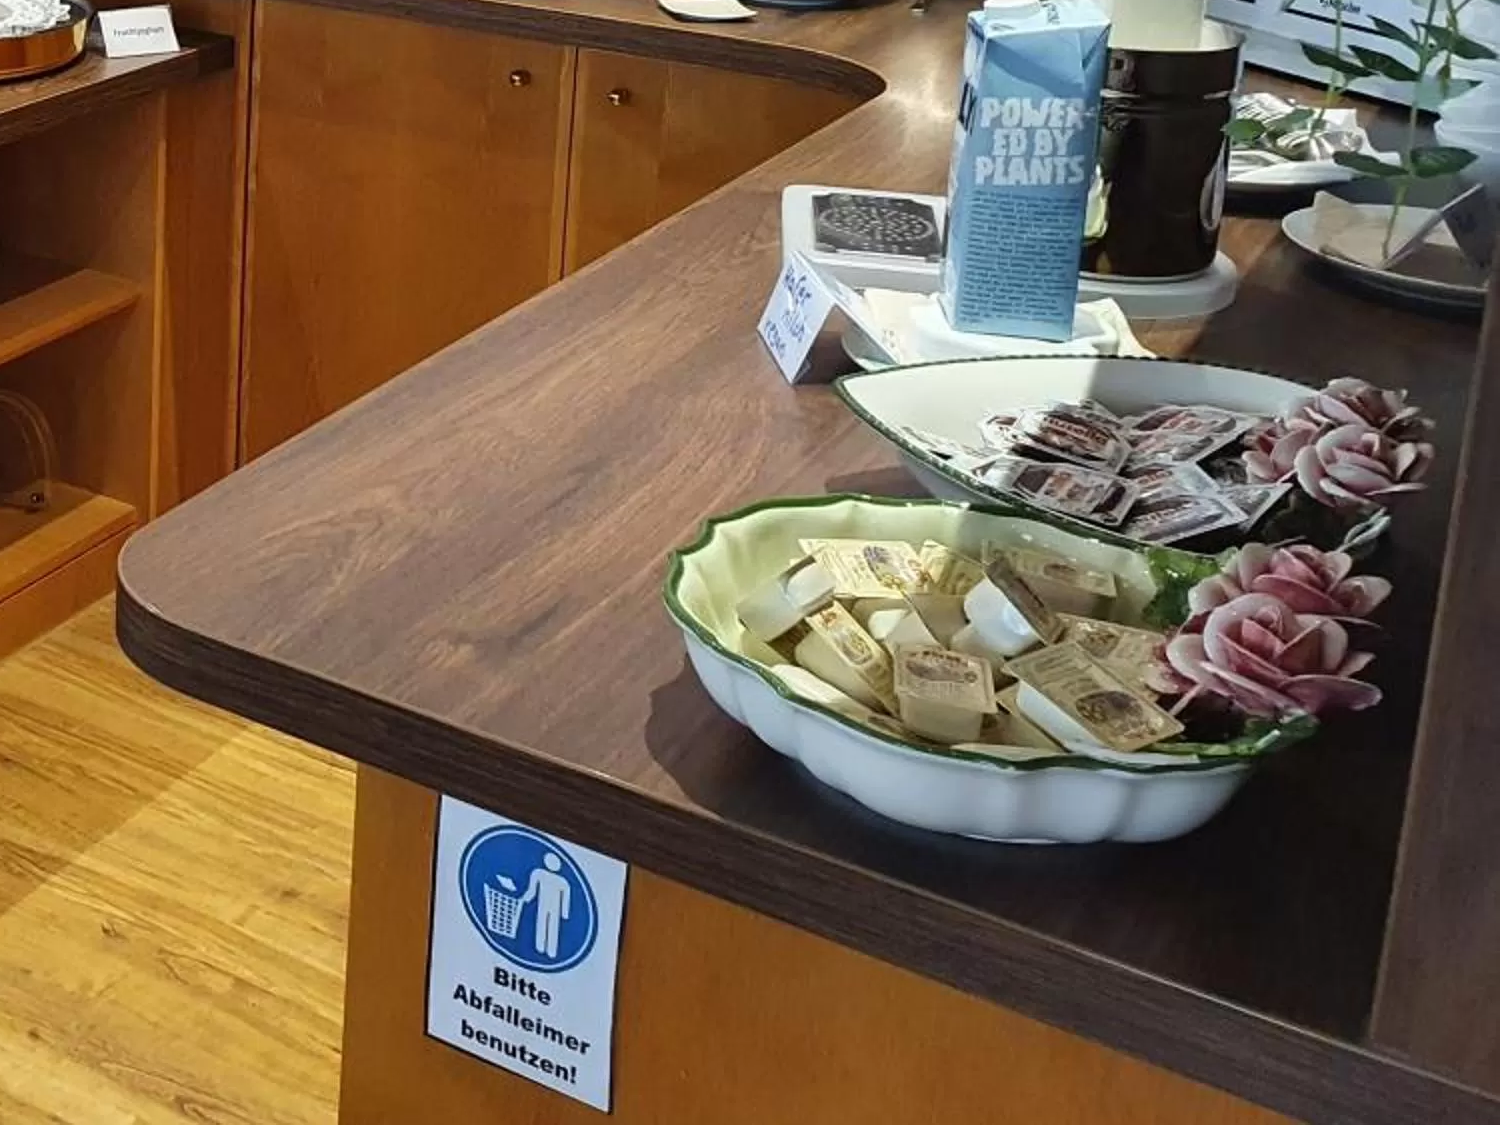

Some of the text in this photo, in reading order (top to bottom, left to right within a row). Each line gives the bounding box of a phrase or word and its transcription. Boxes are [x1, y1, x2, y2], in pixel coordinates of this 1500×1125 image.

[993, 128, 1075, 156] ED BY
[975, 156, 1085, 186] PLANTS
[493, 966, 551, 1005] Bitte
[453, 984, 590, 1054] Abfalleimer
[461, 1019, 576, 1084] benutzen!
